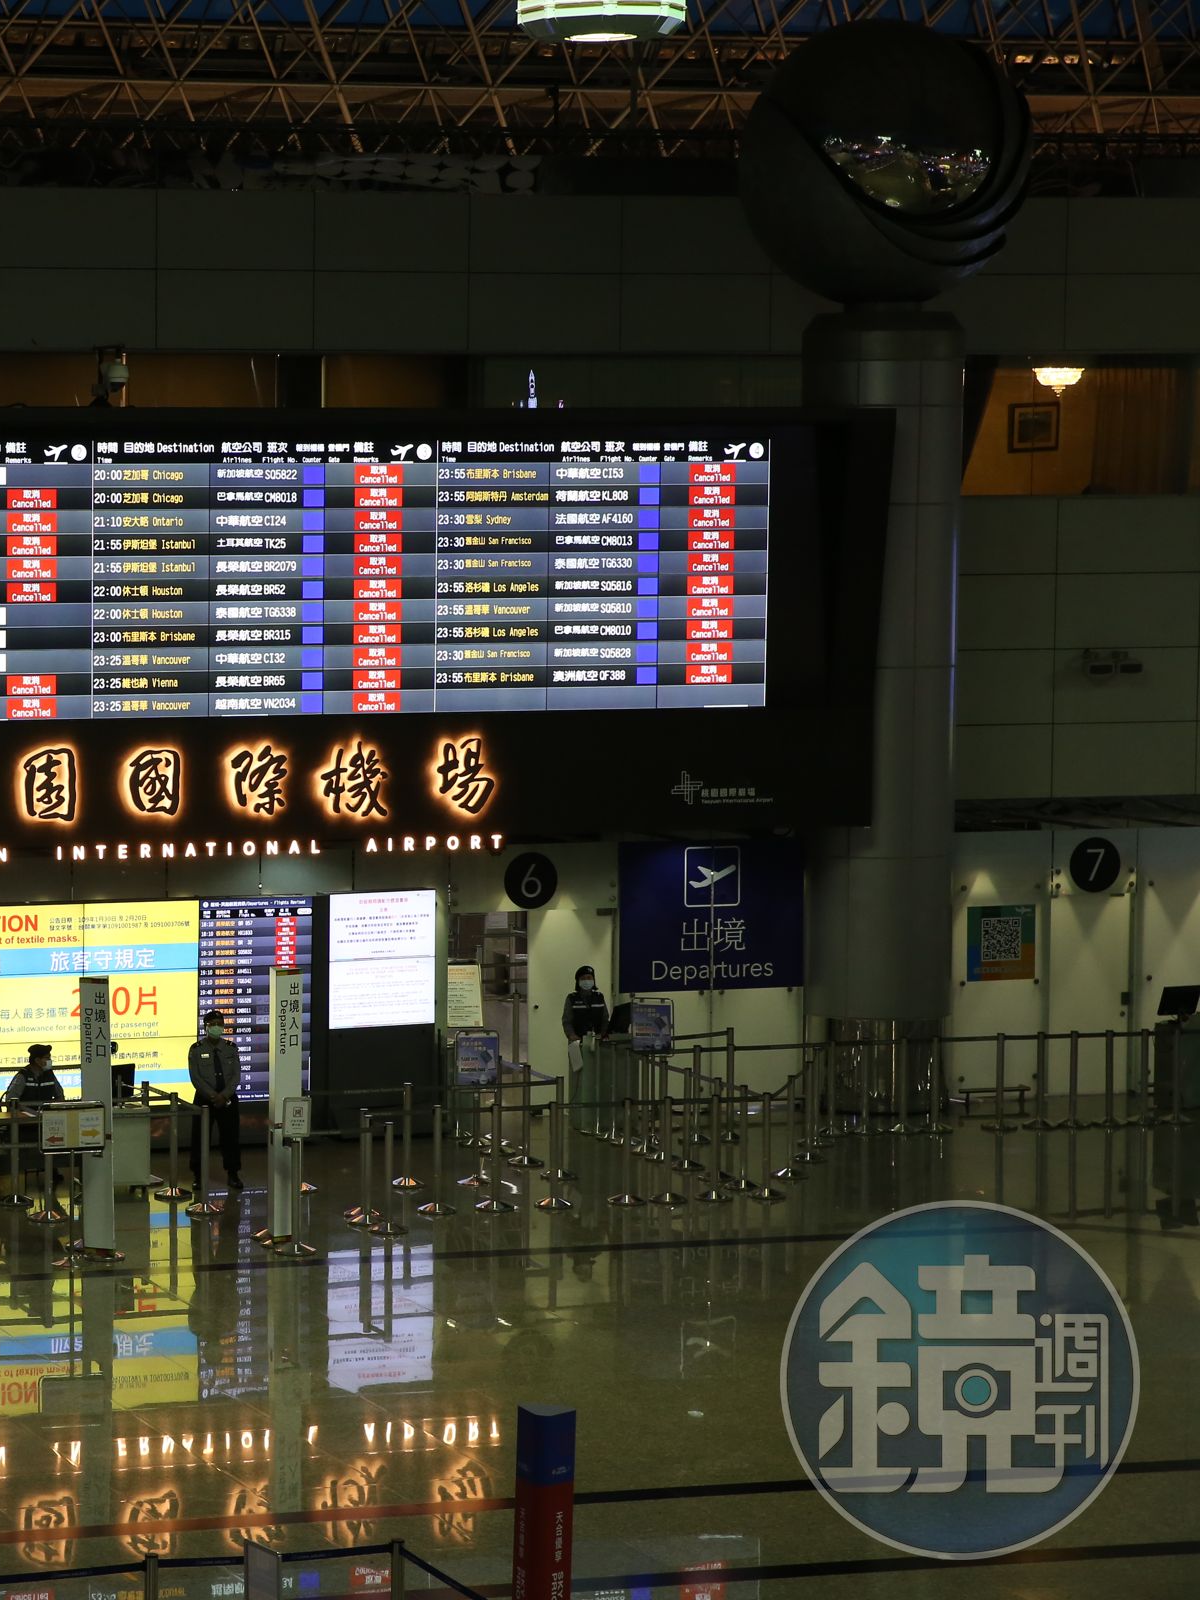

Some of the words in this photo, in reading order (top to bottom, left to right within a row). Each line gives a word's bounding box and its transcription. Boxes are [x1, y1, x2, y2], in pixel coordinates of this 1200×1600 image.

[157, 443, 214, 452] Destination
[500, 442, 554, 452] Destination
[439, 469, 464, 479] 23:55
[464, 469, 499, 479] 布里斯本
[503, 469, 536, 478] Brisbane
[556, 468, 601, 479] 中華航空
[603, 468, 623, 478] CI53
[705, 464, 720, 472] 取消
[23, 490, 40, 498] 取消
[439, 491, 464, 501] 23:55
[511, 492, 548, 501] Amsterdam
[600, 491, 628, 500] KL808
[94, 517, 122, 527] 21:10
[121, 516, 148, 527] 安大略
[153, 517, 183, 526] Ontario
[216, 515, 263, 526] 中華航空
[265, 516, 286, 526] CI24
[370, 512, 386, 520] 取消
[360, 521, 396, 529] Cancelled
[94, 540, 122, 550] 21:55
[123, 539, 157, 550] 伊斯坦堡
[162, 539, 195, 549] Istanbul
[265, 538, 286, 548] TK25
[359, 544, 396, 552] Cancelled
[23, 676, 39, 684] 取消
[437, 673, 463, 683] 23:55
[462, 672, 497, 682] 布里斯本
[501, 672, 533, 681] Brisbane
[12, 686, 50, 694] Cancelled
[57, 840, 321, 861] INTERNATIONAL
[367, 834, 504, 853] AIRPORT
[1085, 848, 1106, 882] 7
[521, 863, 541, 898] 6
[5, 936, 14, 944] of
[16, 935, 44, 944] textile
[48, 935, 80, 943] masks.
[681, 917, 746, 953] 出境
[50, 948, 155, 972] 旅客守規定
[651, 958, 774, 982] Departures
[70, 986, 158, 1018] 20片
[289, 982, 299, 1047] 出境入口
[20, 1024, 52, 1032] allowance
[120, 1021, 159, 1030] passenger
[94, 992, 106, 1058] 出境入口
[280, 1000, 288, 1054] Departure
